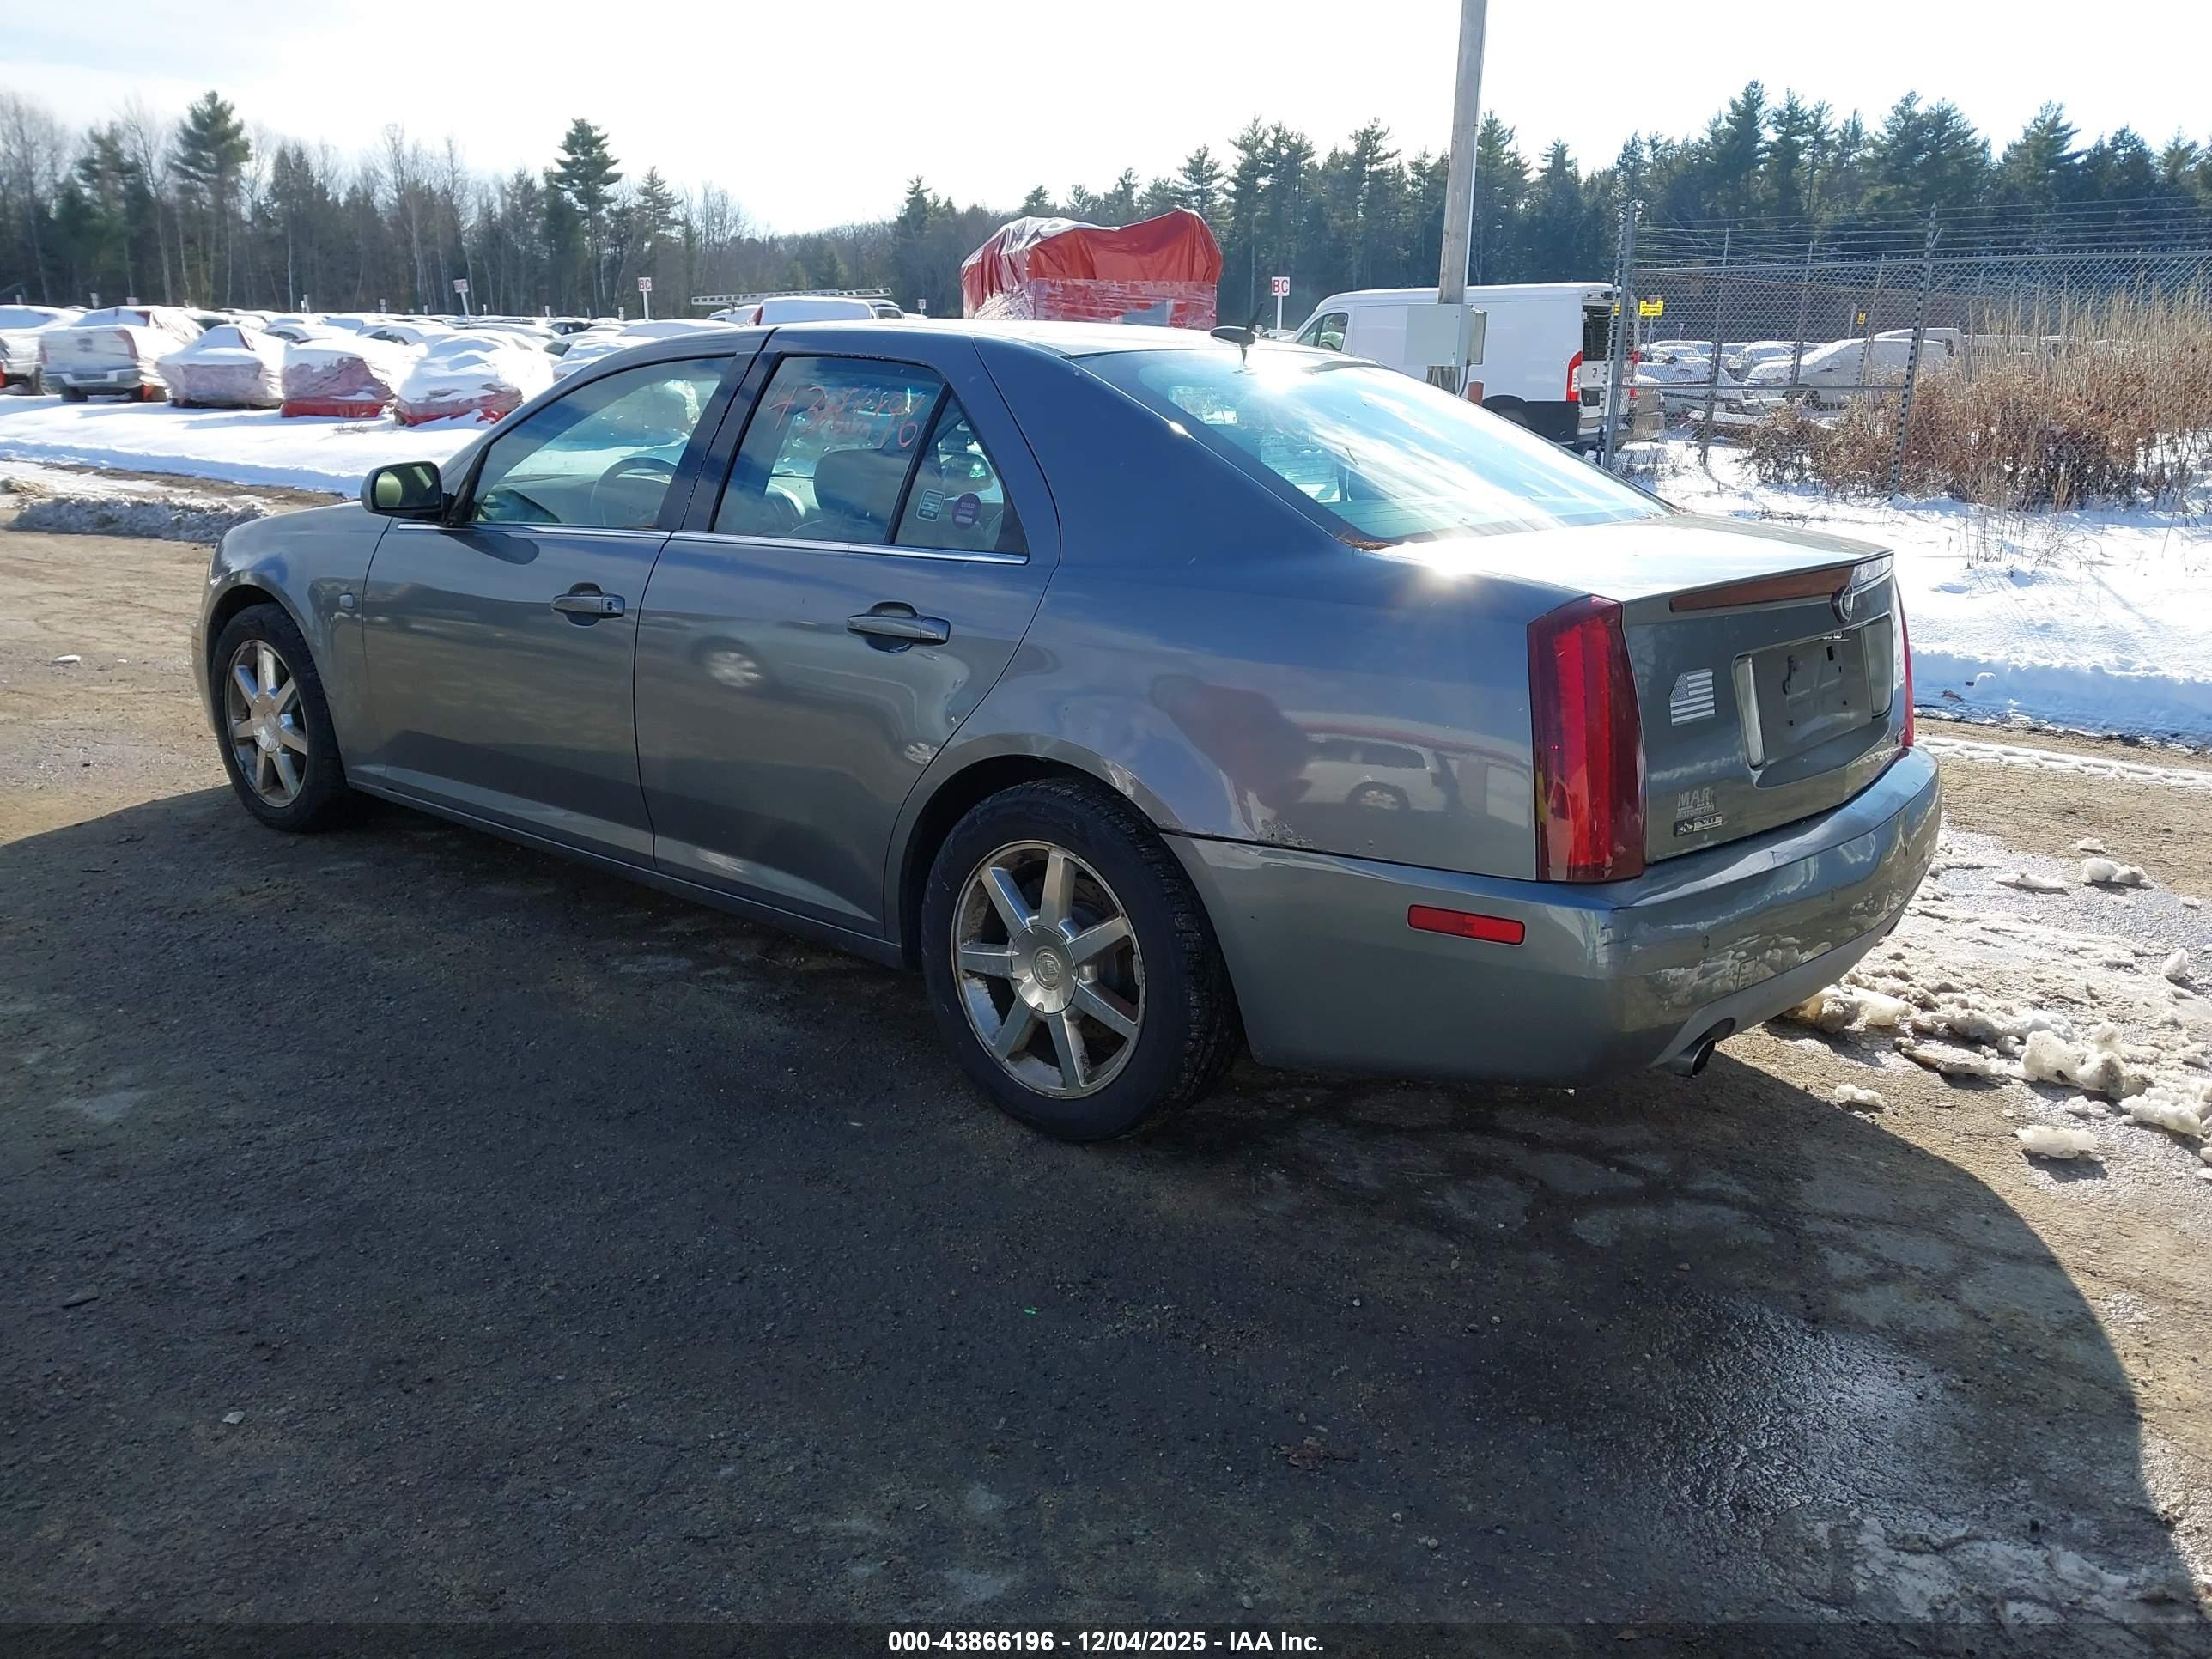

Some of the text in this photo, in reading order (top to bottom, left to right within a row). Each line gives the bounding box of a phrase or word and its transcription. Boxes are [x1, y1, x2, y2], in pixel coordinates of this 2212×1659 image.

[453, 280, 466, 290] BC
[639, 279, 651, 289] BC
[1273, 279, 1289, 294] BC
